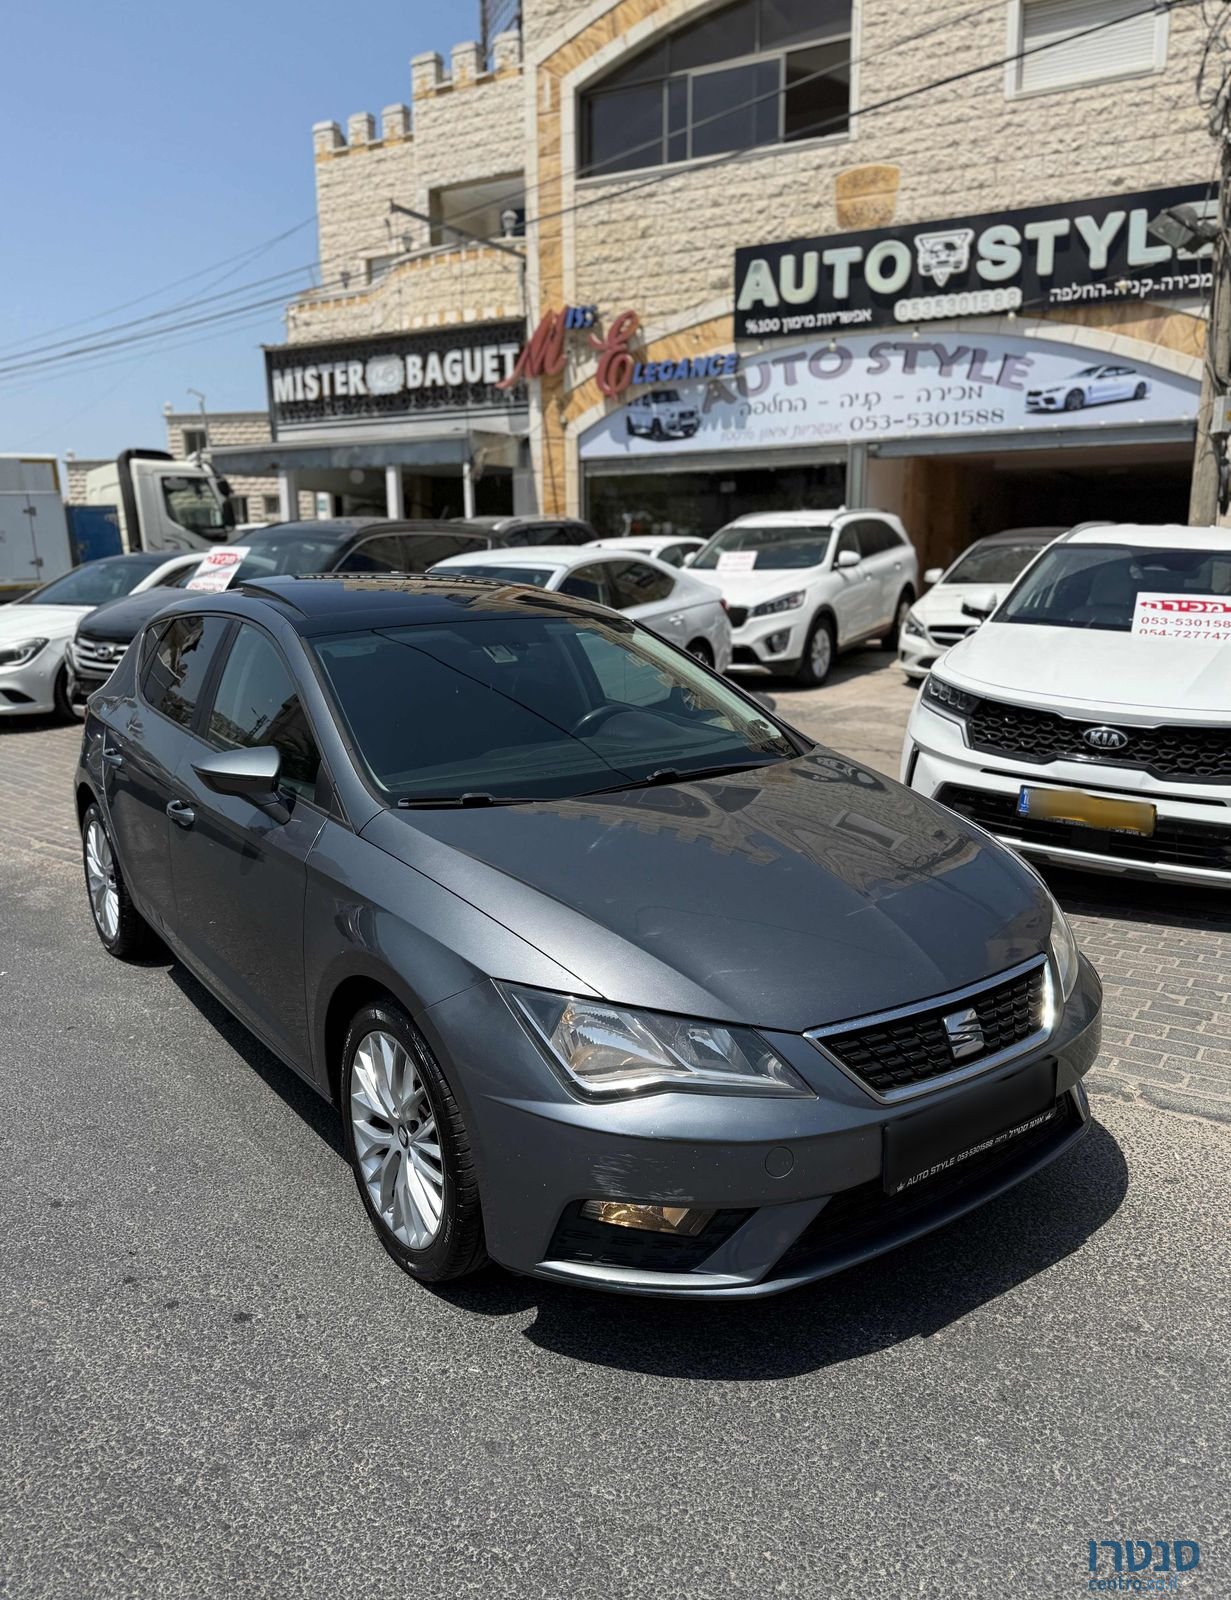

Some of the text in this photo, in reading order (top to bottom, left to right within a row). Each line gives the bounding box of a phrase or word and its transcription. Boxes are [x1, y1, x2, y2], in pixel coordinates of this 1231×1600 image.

[737, 240, 912, 310] AUTO
[894, 287, 1022, 322] 0535301588
[495, 305, 740, 398] MISS ELEGANCE
[273, 360, 369, 404] MISTER
[405, 342, 520, 391] BAGUET
[701, 341, 1035, 415] AUTO STYLE
[916, 385, 983, 403] מכירה
[849, 408, 1005, 432] 053-5301588
[1090, 731, 1120, 746] KIA
[907, 1169, 929, 1187] AUTO
[930, 1157, 956, 1175] STYLE
